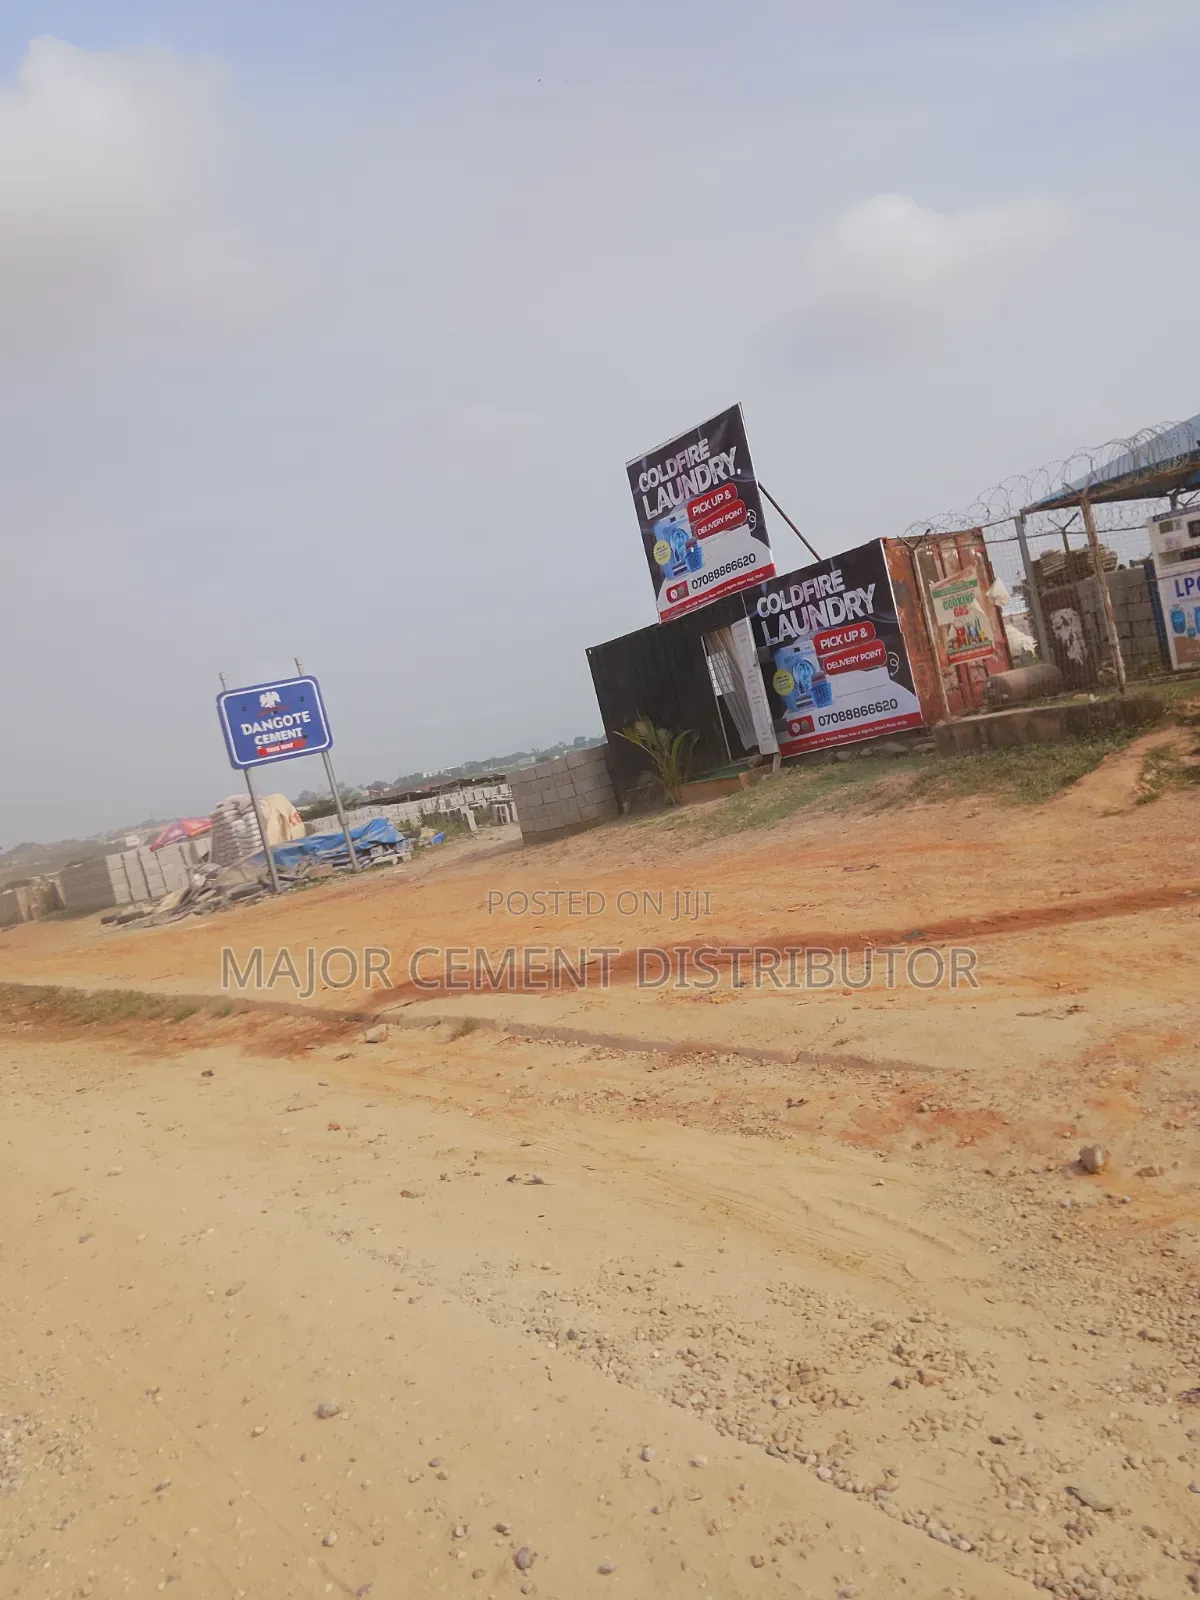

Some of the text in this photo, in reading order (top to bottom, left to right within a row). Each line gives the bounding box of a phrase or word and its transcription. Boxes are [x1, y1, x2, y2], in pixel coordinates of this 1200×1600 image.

[639, 438, 711, 493] COLDFIRE
[642, 446, 742, 519] LAUNDRY.
[693, 489, 732, 516] PICK UP &
[698, 507, 743, 535] DELIVERY POINT
[691, 553, 756, 590] 07088866620
[756, 569, 846, 617] COLDFIRE
[761, 584, 875, 646] LAUNDRY
[954, 606, 969, 617] GAS
[820, 628, 868, 649] PICK UP &
[826, 649, 882, 671] DELIVERY POINT
[240, 711, 312, 736] DANGOTE
[818, 698, 898, 727] 07088866620
[254, 728, 303, 745] CEMENT
